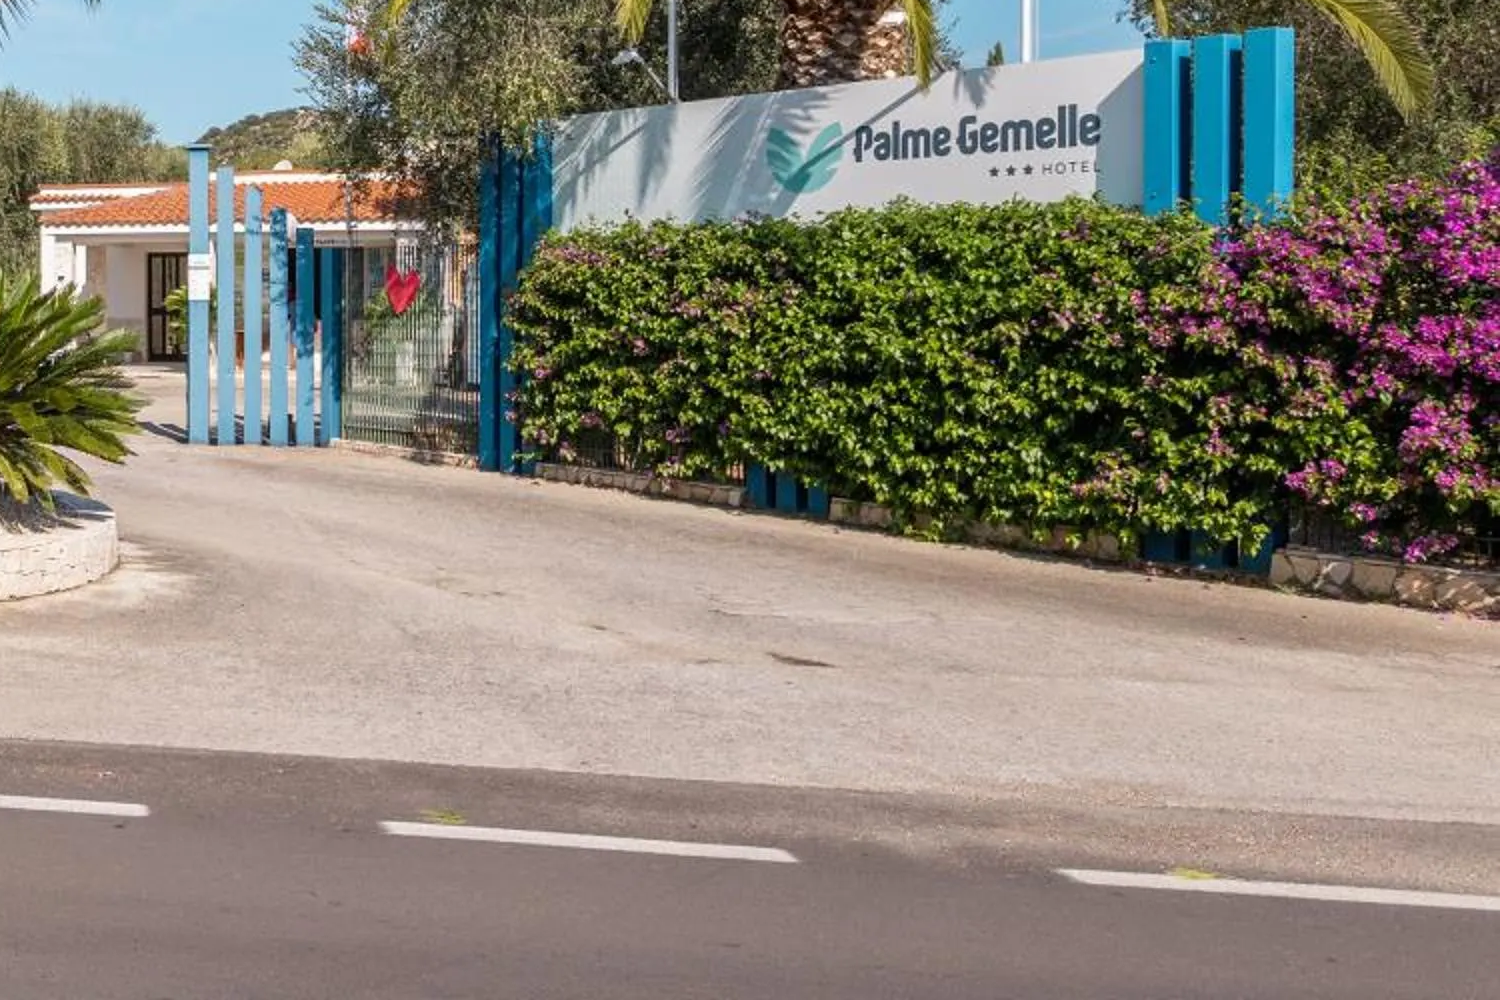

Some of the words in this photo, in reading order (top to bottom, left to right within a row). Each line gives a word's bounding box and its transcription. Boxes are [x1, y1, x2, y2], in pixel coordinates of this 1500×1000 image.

[853, 120, 950, 163] Palme
[956, 103, 1101, 155] Gemelle
[1041, 161, 1101, 175] HOTEL
